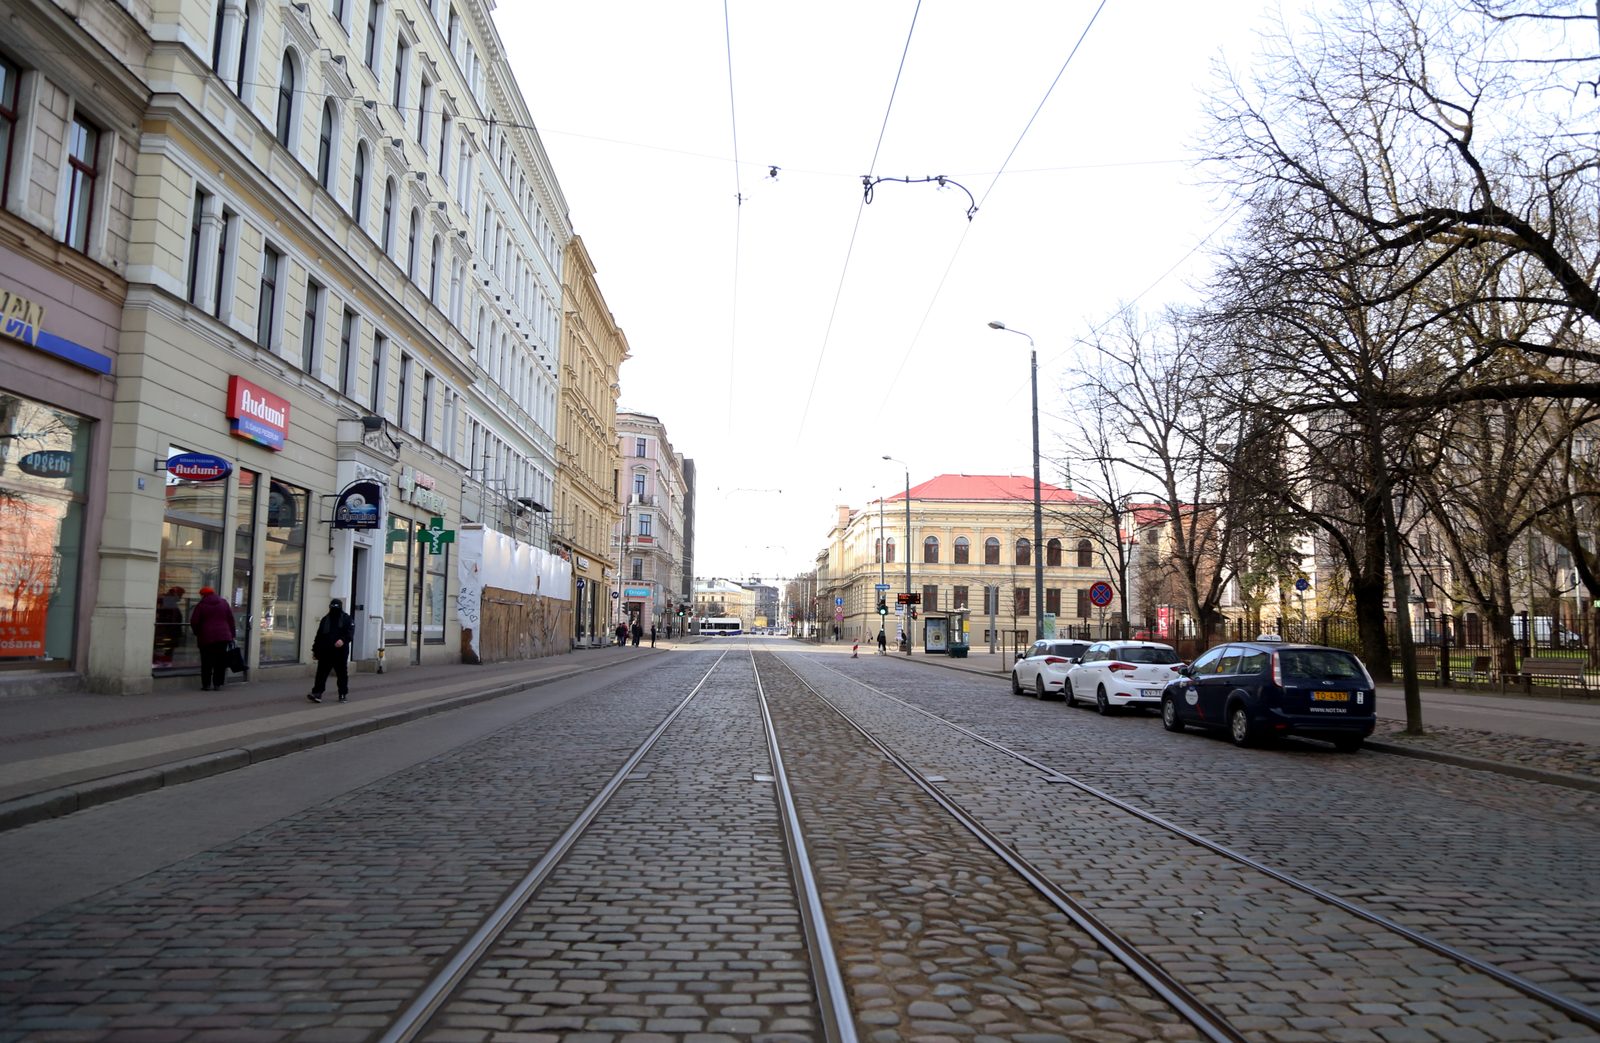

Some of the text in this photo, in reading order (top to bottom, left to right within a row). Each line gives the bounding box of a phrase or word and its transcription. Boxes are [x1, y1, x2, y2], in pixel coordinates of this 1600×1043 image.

[241, 389, 285, 428] Audumi
[175, 464, 219, 475] Audumi
[0, 638, 41, 649] ošana
